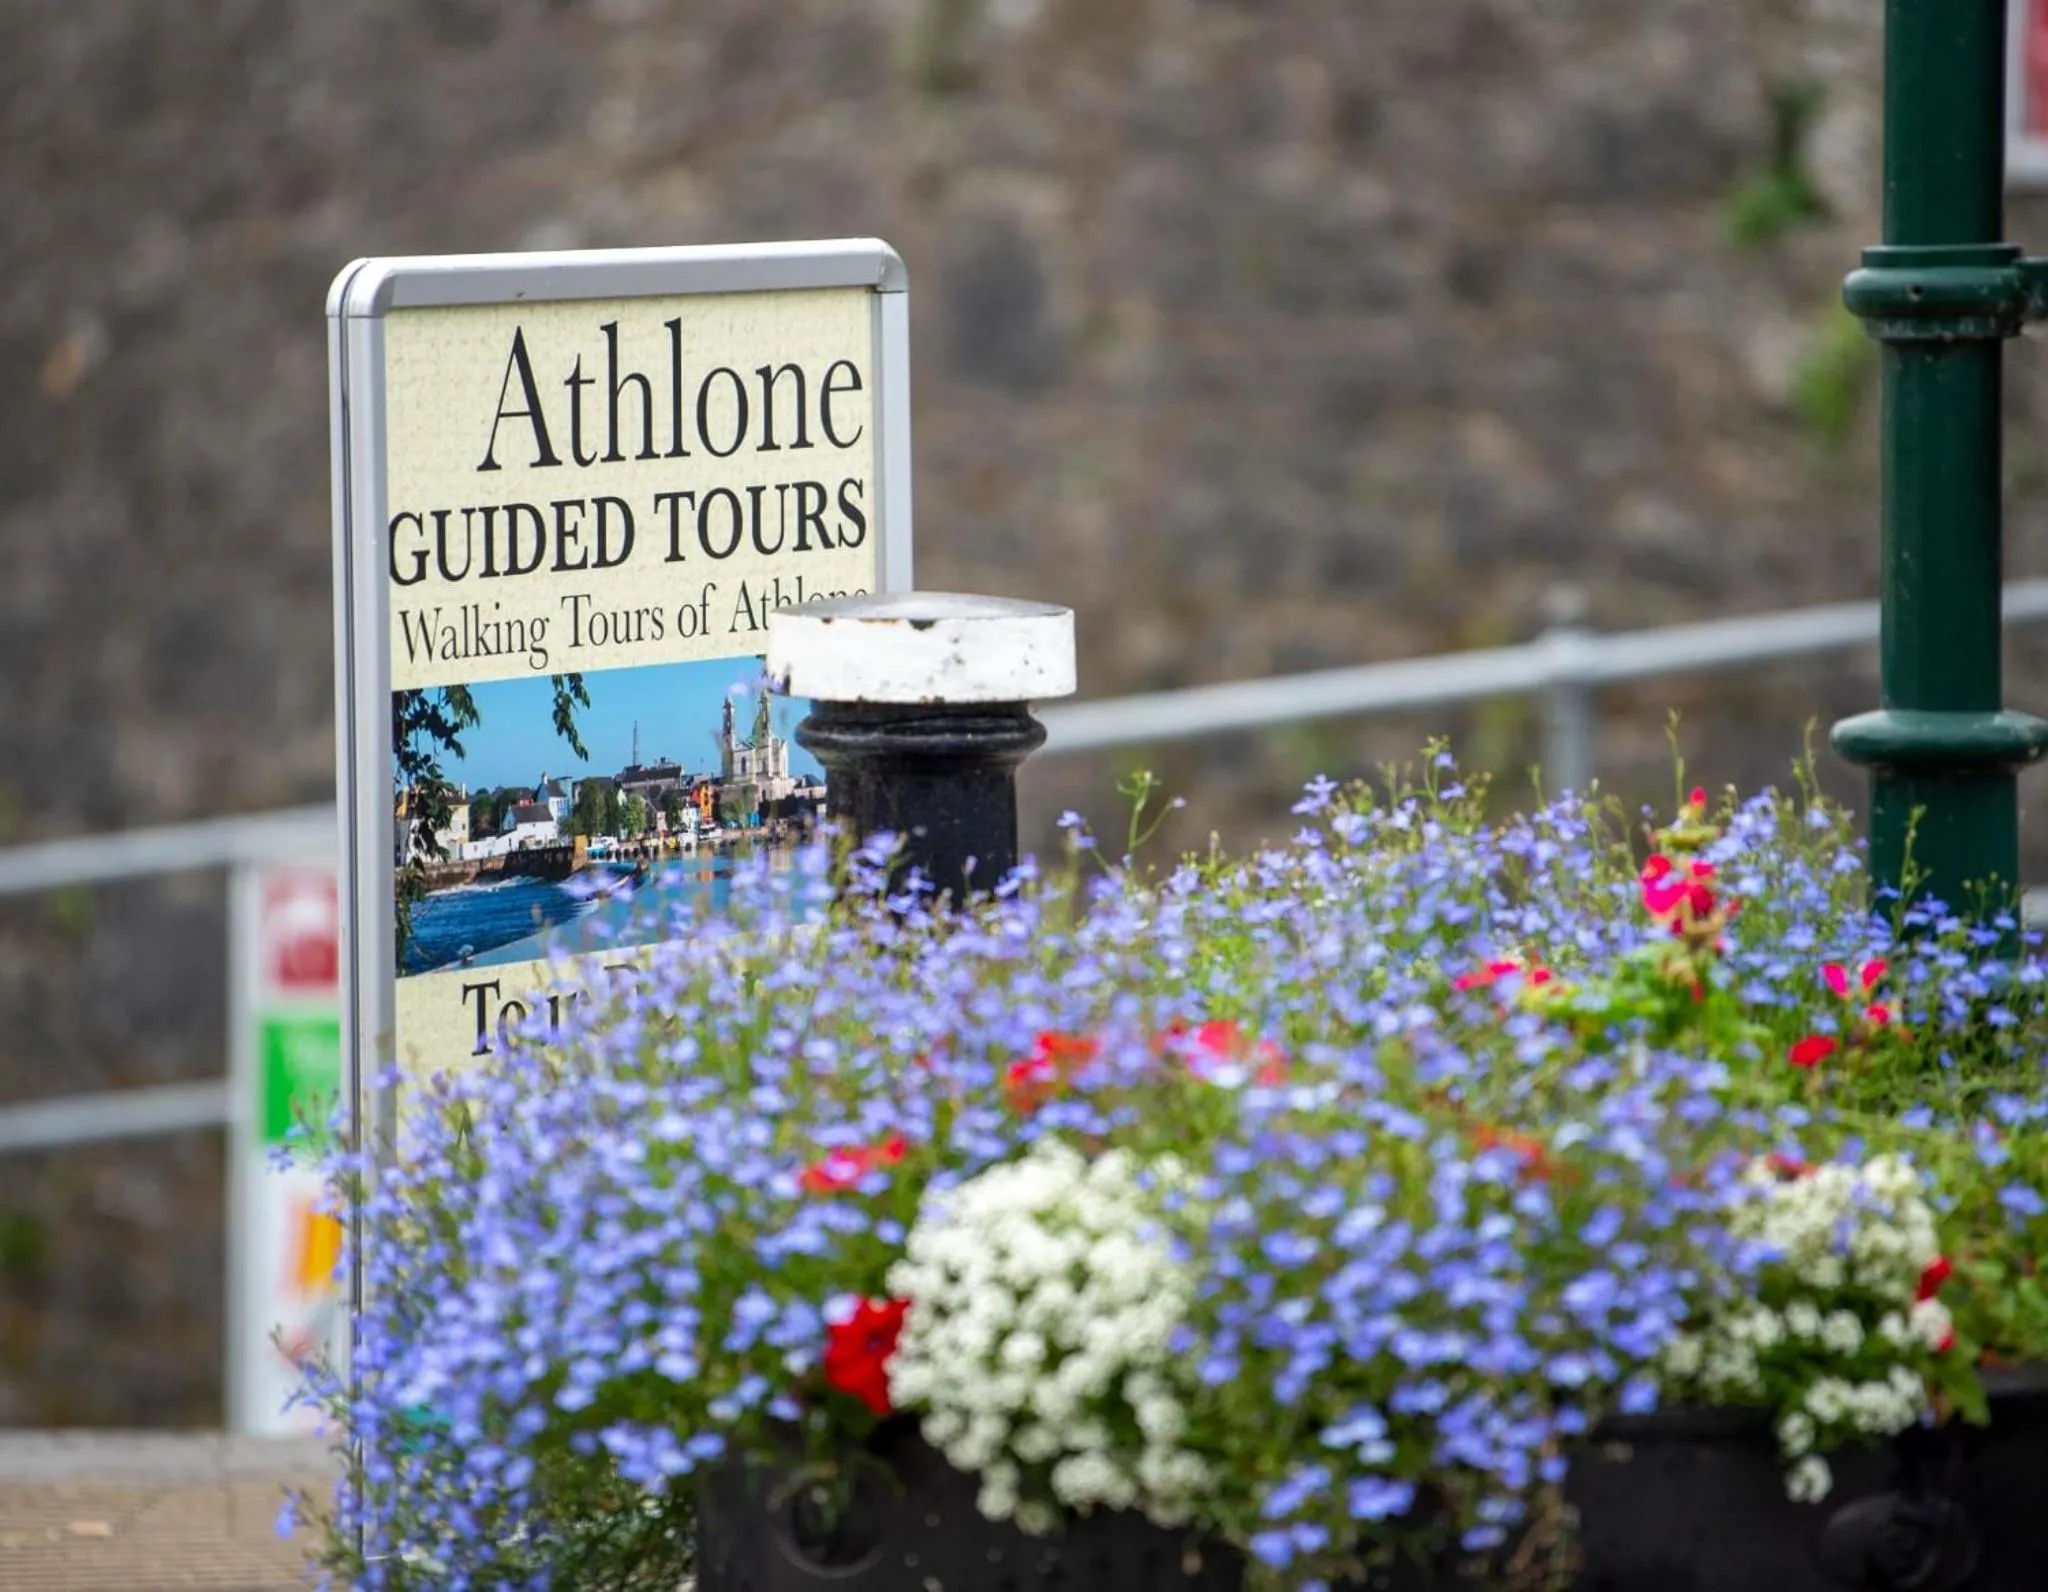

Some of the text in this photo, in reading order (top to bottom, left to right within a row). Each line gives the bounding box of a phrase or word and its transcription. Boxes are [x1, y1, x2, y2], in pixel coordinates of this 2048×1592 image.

[476, 318, 864, 472] Athlone
[388, 477, 867, 587] GUIDED TOURS
[399, 602, 551, 671] Walking
[561, 594, 665, 648] Tours
[677, 583, 717, 637] of
